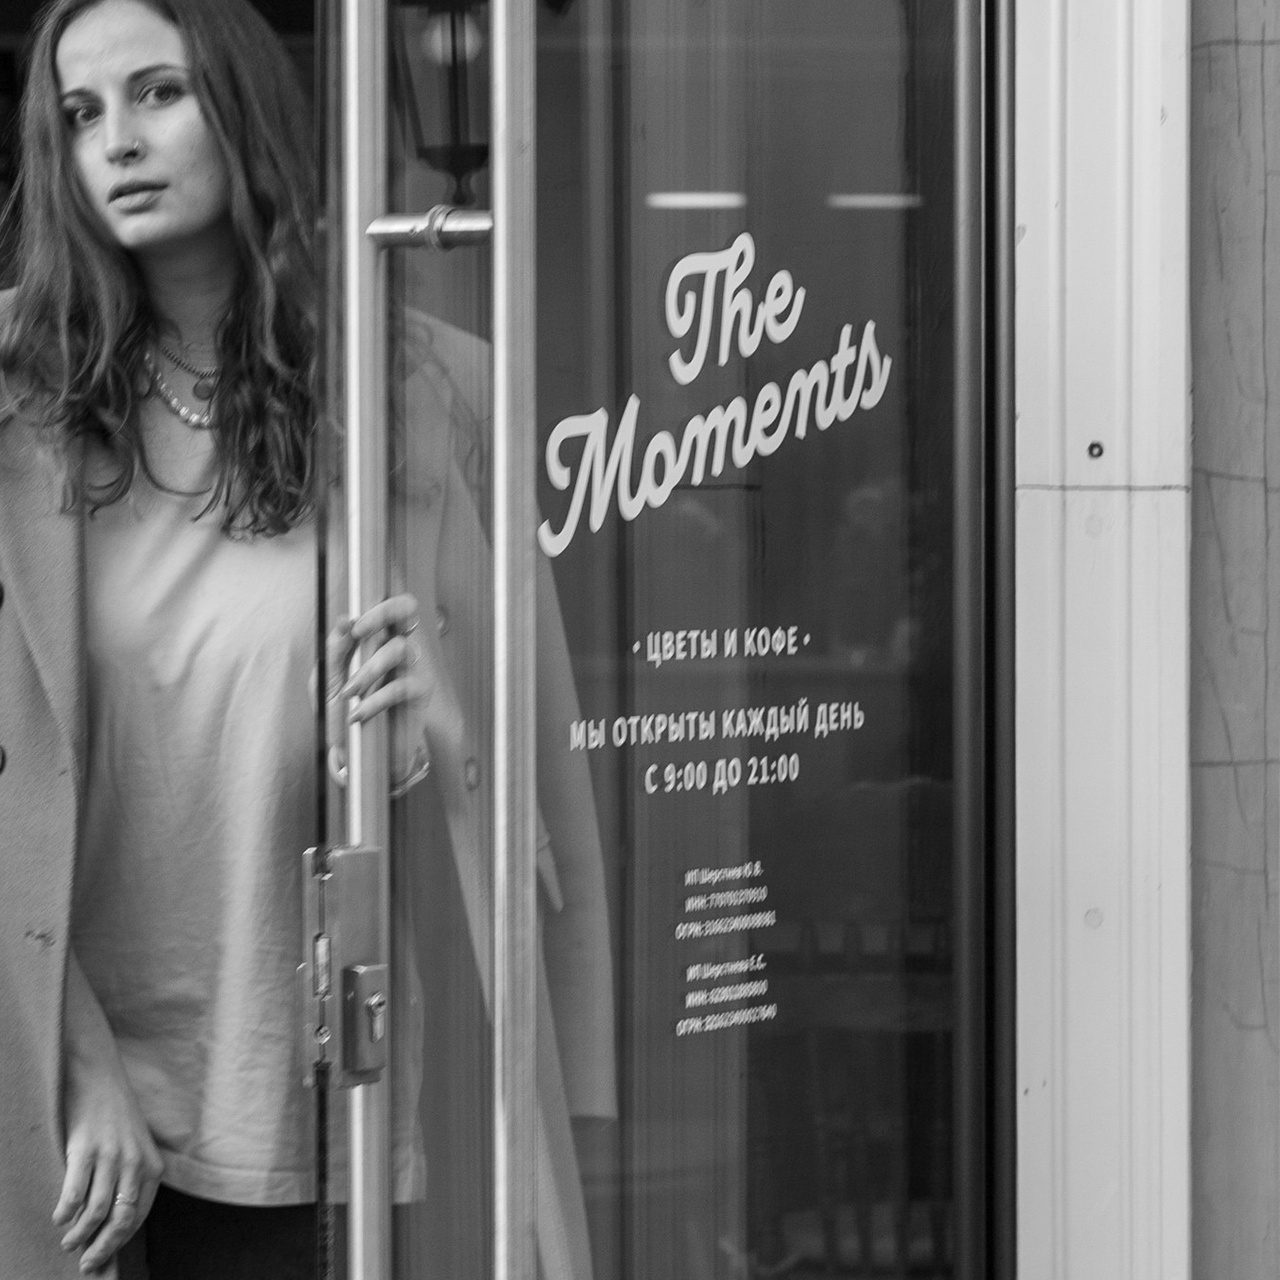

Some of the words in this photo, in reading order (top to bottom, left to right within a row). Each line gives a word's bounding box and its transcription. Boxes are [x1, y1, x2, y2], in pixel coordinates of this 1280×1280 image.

[665, 231, 806, 386] The
[537, 320, 893, 558] Moments
[646, 628, 718, 668] ЦВЕТЫ
[723, 627, 738, 658] И
[744, 625, 799, 658] КОФЕ
[570, 718, 606, 751] МЫ
[612, 710, 716, 748] ОТКРЫТЫ
[722, 696, 810, 743] КАЖДЫЙ
[814, 701, 866, 739] ДЕНЬ
[644, 764, 659, 795] С
[664, 761, 708, 793] 9:00
[712, 757, 742, 796] ДО
[747, 753, 800, 786] 21:00
